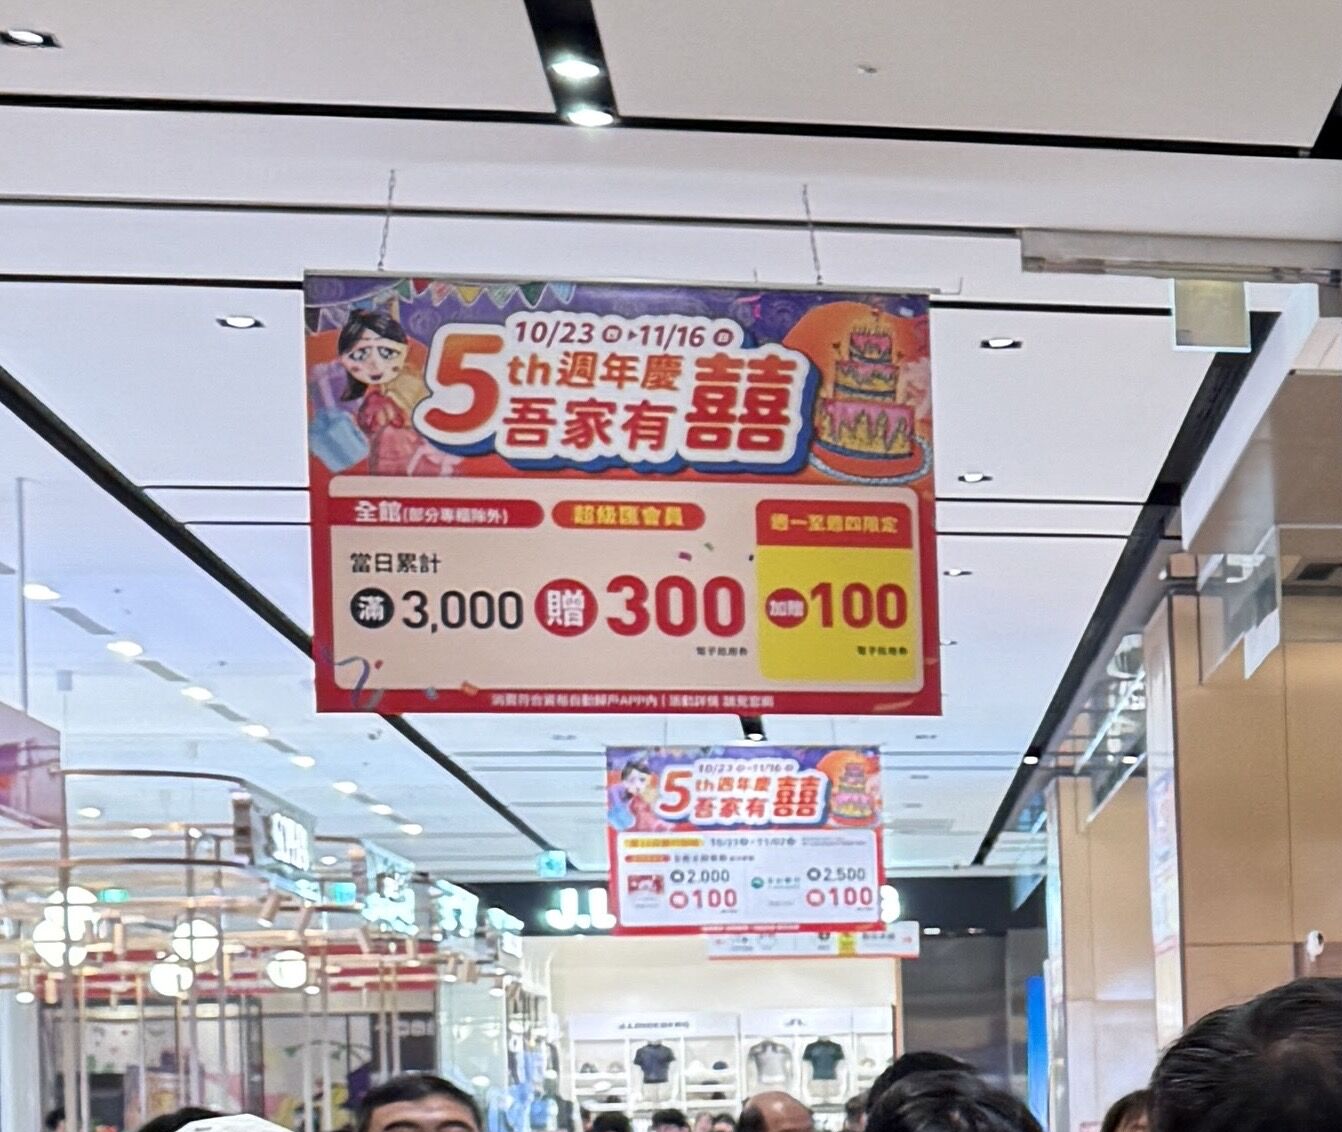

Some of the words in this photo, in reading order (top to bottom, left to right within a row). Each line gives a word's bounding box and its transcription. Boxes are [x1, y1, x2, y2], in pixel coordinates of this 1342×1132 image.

[516, 321, 595, 348] 10/23
[640, 324, 706, 350] 11/16
[350, 553, 441, 573] 當日累計
[402, 590, 524, 633] 3,000
[606, 575, 745, 637] 300
[810, 582, 908, 629] 100
[693, 889, 737, 908] 100
[828, 887, 873, 907] 100
